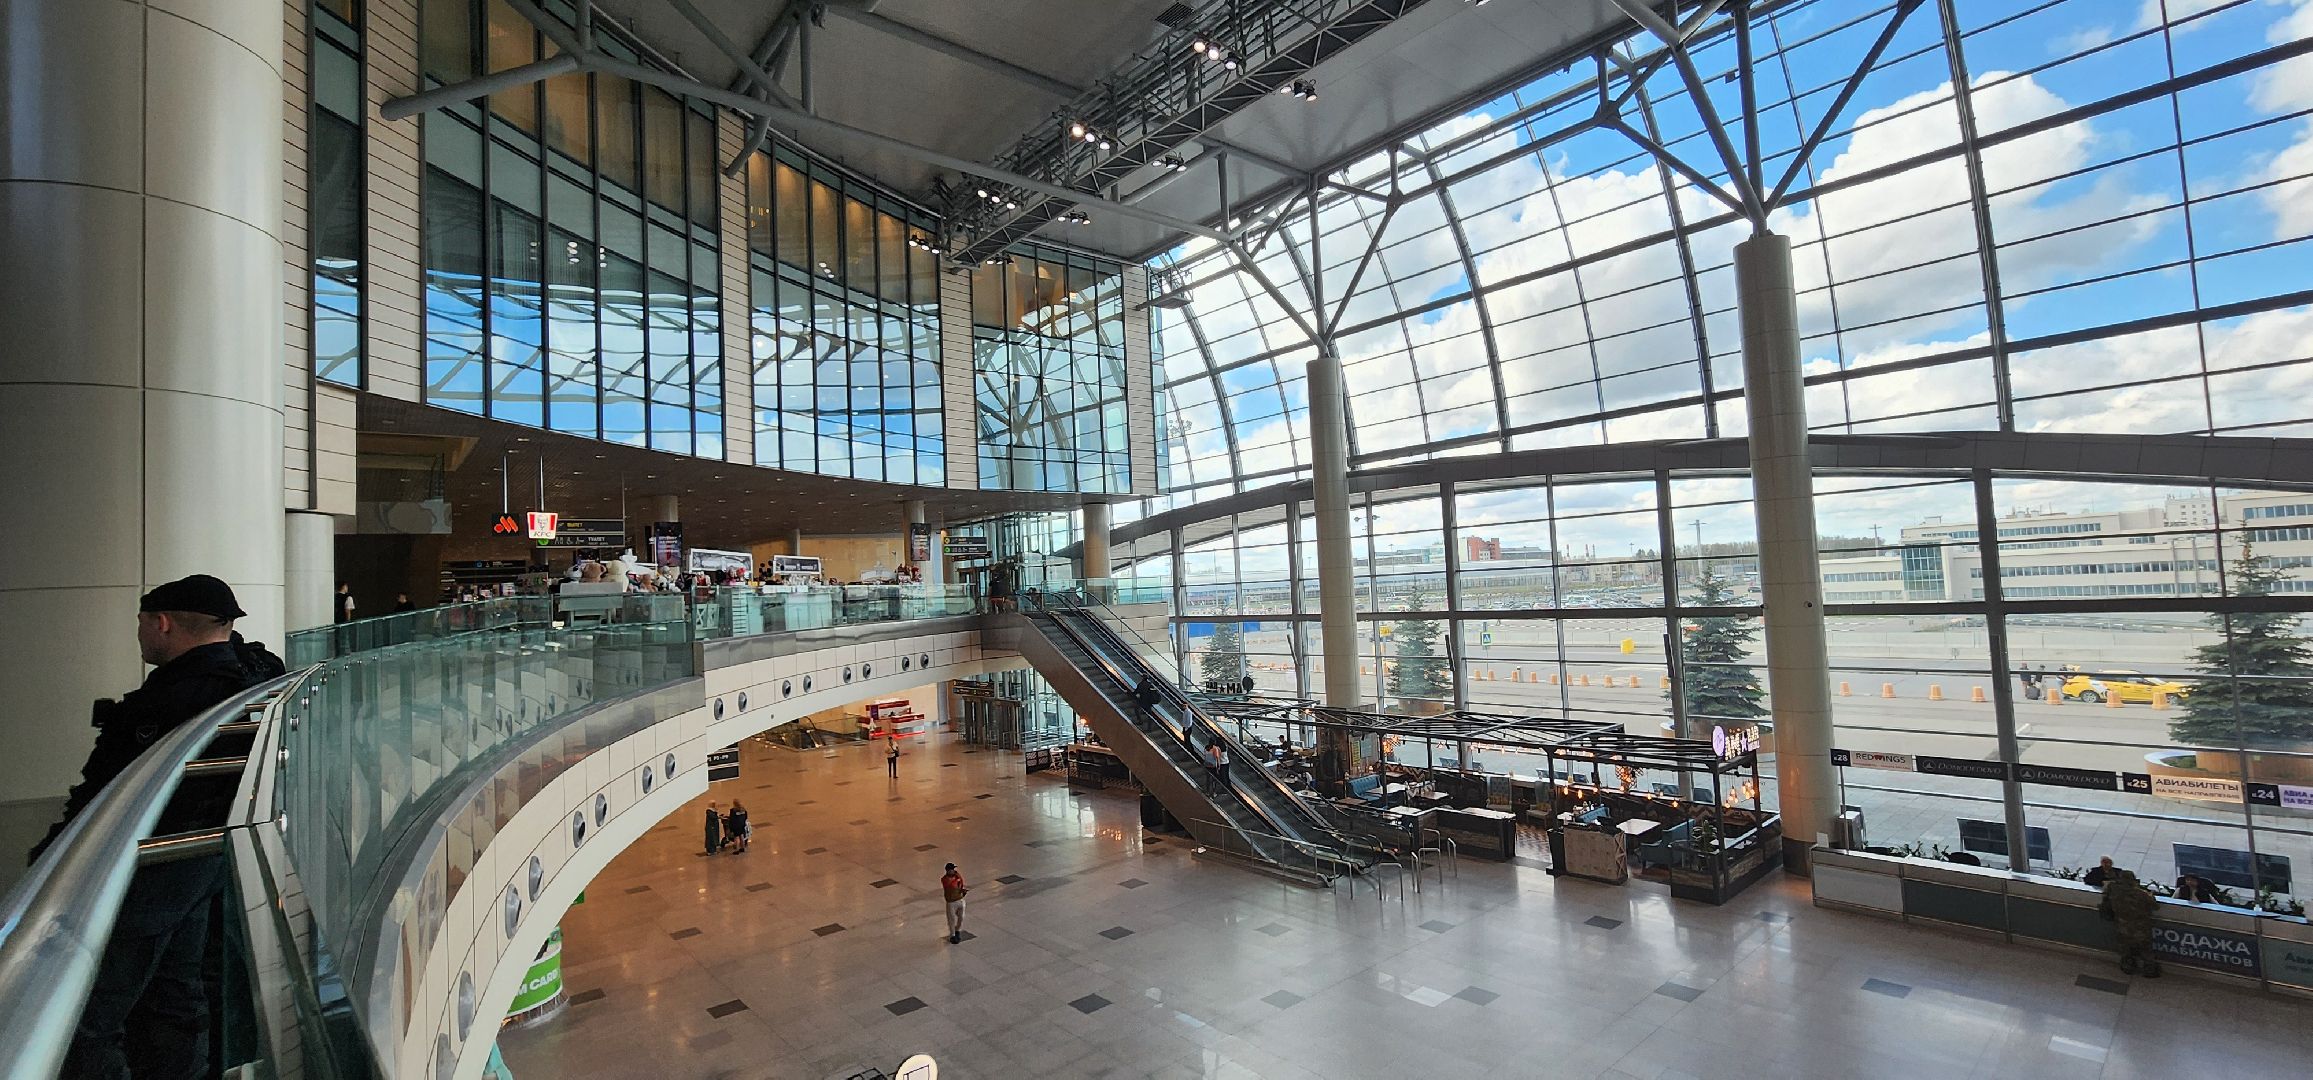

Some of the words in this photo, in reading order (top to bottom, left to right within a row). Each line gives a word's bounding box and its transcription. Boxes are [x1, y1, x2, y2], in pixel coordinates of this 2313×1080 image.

[2156, 779, 2239, 791] АВИАБИЛЕТЫ
[2284, 790, 2307, 798] АВИА
[2151, 927, 2251, 955] РОДАЖА
[530, 969, 558, 990] CARD
